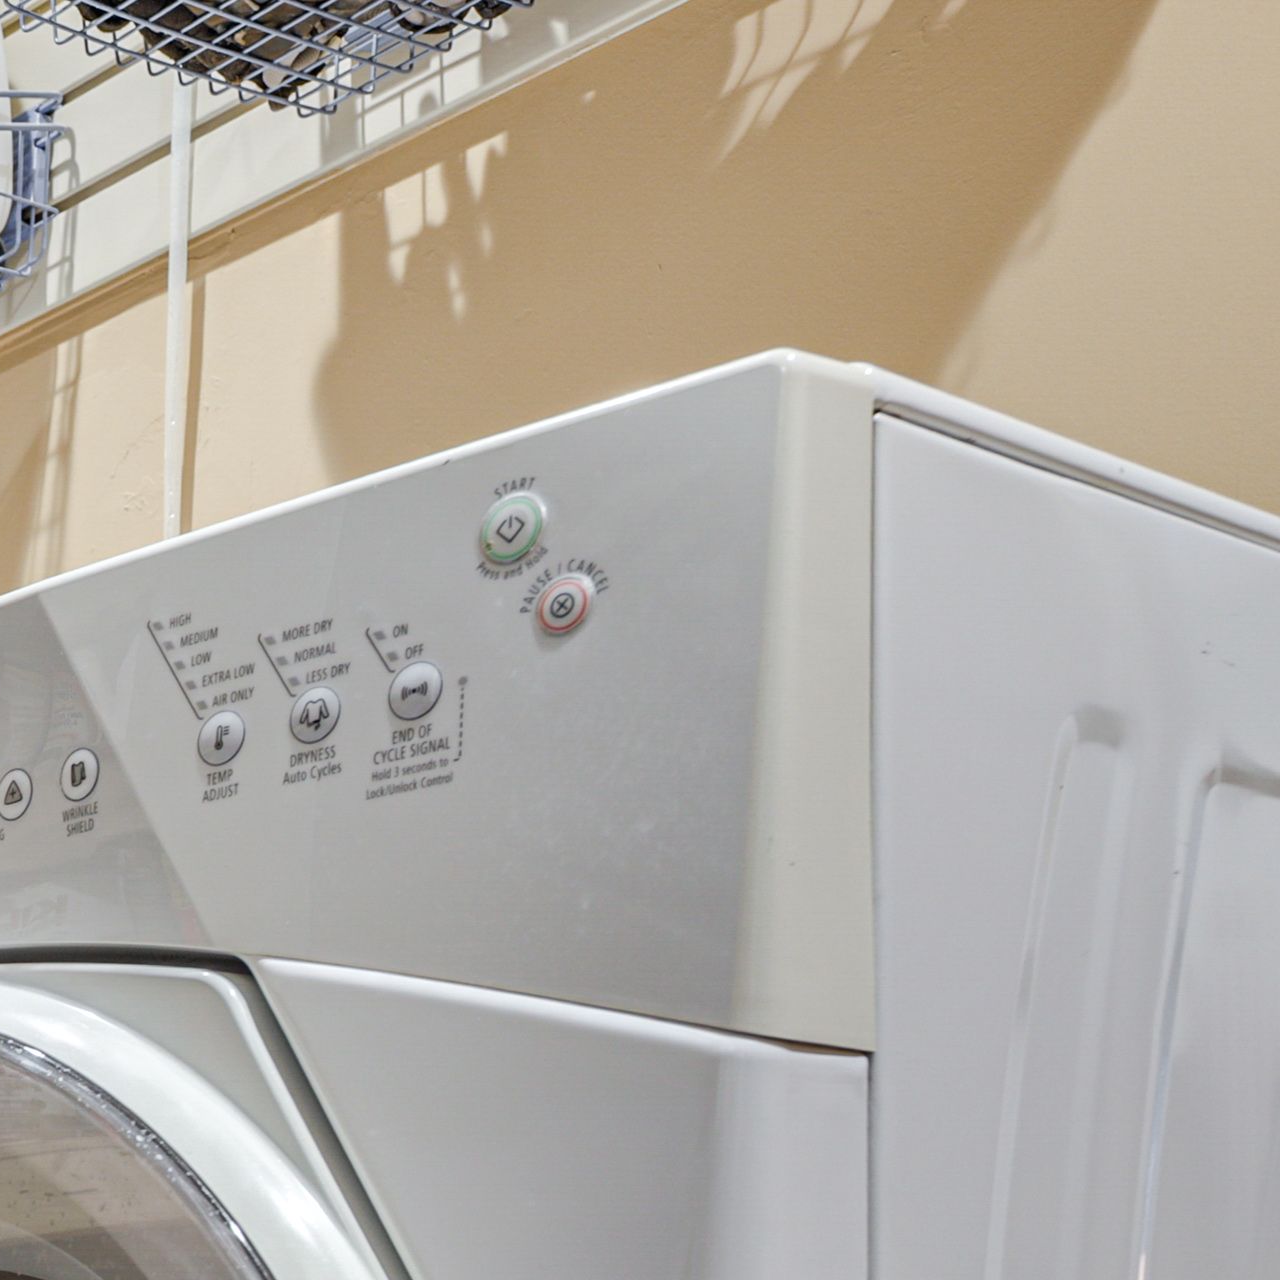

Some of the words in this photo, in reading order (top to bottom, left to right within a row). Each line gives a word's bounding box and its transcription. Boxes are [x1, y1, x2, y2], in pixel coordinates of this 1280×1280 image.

[494, 477, 536, 500] START
[476, 561, 500, 580] Press
[504, 567, 523, 580] and
[525, 547, 549, 570] Hold
[520, 569, 554, 614] PAUSE
[567, 558, 610, 595] CANCEL
[169, 613, 192, 629] HIGH
[282, 624, 311, 643] MORE
[313, 618, 334, 636] DRY
[392, 623, 409, 639] ON
[180, 627, 219, 648] MEDIUM
[191, 651, 212, 667] LOW
[293, 641, 336, 664] NORMAL
[404, 643, 424, 660] OFF
[201, 669, 232, 688] EXTRA
[234, 663, 256, 680] LOW
[305, 667, 329, 685] LESS
[330, 661, 351, 679] DRY
[211, 692, 228, 708] AIR
[230, 686, 255, 703] ONLY
[392, 728, 415, 745] END
[418, 723, 433, 738] OF
[289, 745, 336, 768] DRYNESS
[372, 744, 406, 766] CYCLE
[410, 737, 450, 757] SIGNAL
[207, 768, 234, 786] TEMP
[282, 769, 307, 785] Auto
[310, 762, 342, 782] Cycles
[371, 766, 392, 782] Hold
[394, 765, 400, 777] 3
[402, 759, 437, 777] seconds
[439, 757, 449, 769] to
[202, 783, 239, 803] ADJUST
[366, 781, 418, 800] Lock/Unlock
[420, 772, 454, 789] Control
[62, 801, 99, 823] WRINKLE
[66, 818, 95, 837] SHIELD
